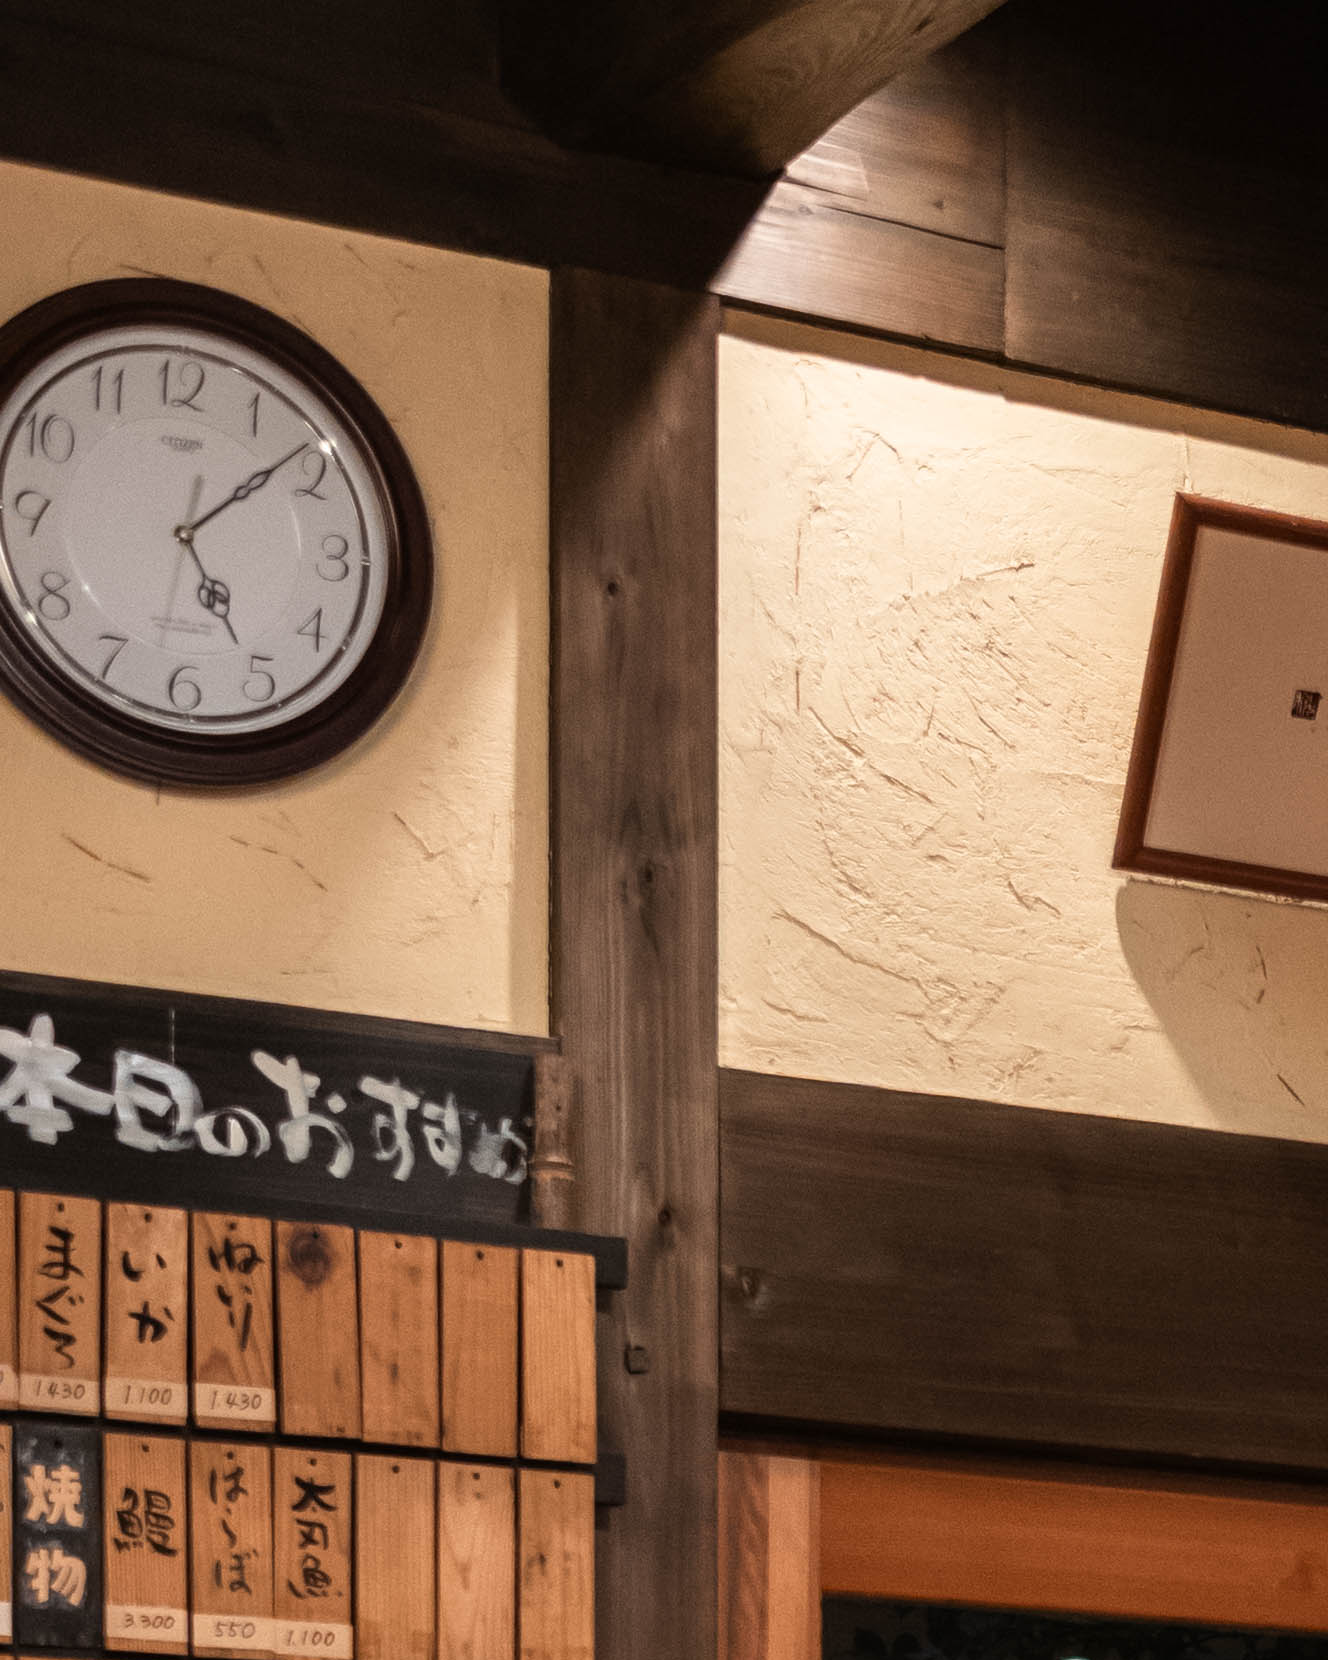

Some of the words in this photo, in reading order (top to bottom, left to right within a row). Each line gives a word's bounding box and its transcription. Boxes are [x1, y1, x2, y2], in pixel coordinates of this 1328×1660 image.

[91, 365, 125, 415] 11
[162, 360, 206, 412] 12
[26, 412, 75, 464] 10
[246, 391, 261, 438] 1
[293, 449, 328, 501] 2
[15, 490, 52, 537] 9
[315, 534, 350, 582] 3
[38, 571, 70, 621] 8
[297, 607, 328, 653] 4
[99, 634, 128, 680] 7
[242, 655, 276, 701] 5
[168, 666, 201, 711] 6
[122, 1251, 175, 1344] いか
[24, 1464, 86, 1607] 焼物
[215, 1621, 256, 1640] 550
